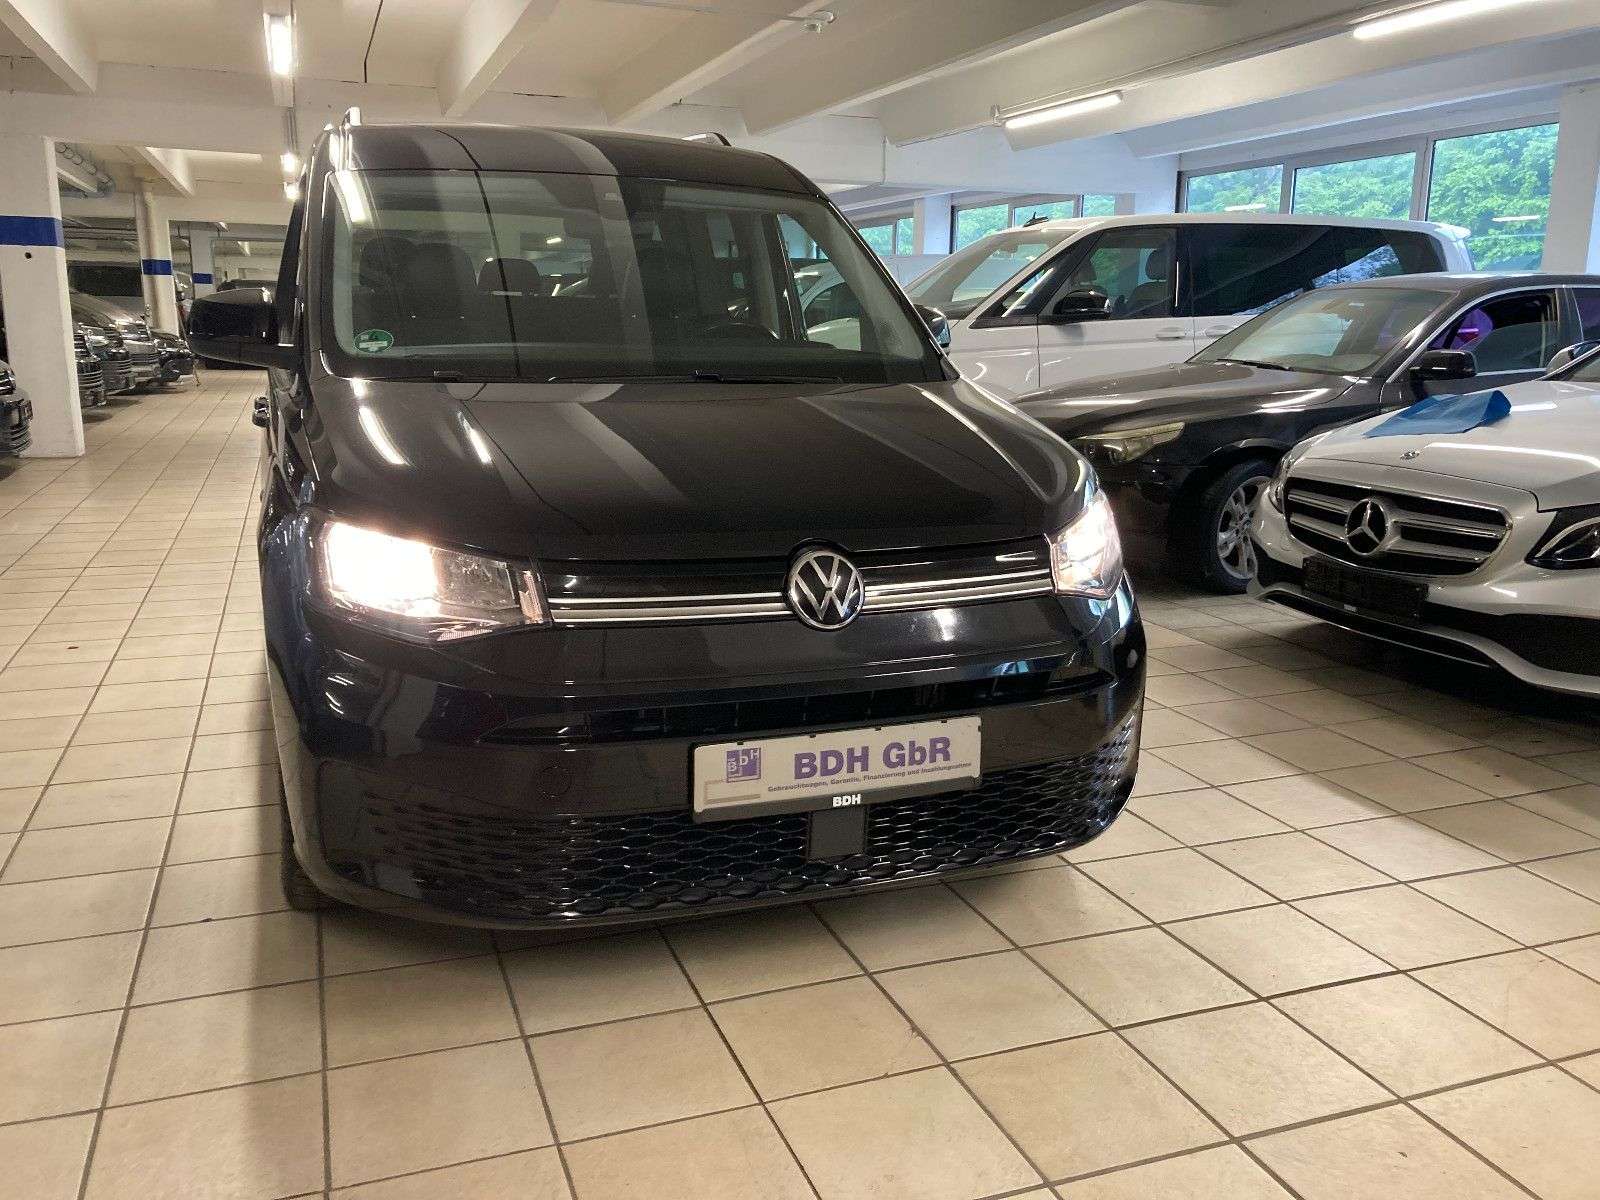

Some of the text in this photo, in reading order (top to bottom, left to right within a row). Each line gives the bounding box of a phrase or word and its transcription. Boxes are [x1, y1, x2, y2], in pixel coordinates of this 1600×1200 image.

[794, 737, 951, 780] BDH GbR
[832, 794, 861, 808] BDH
